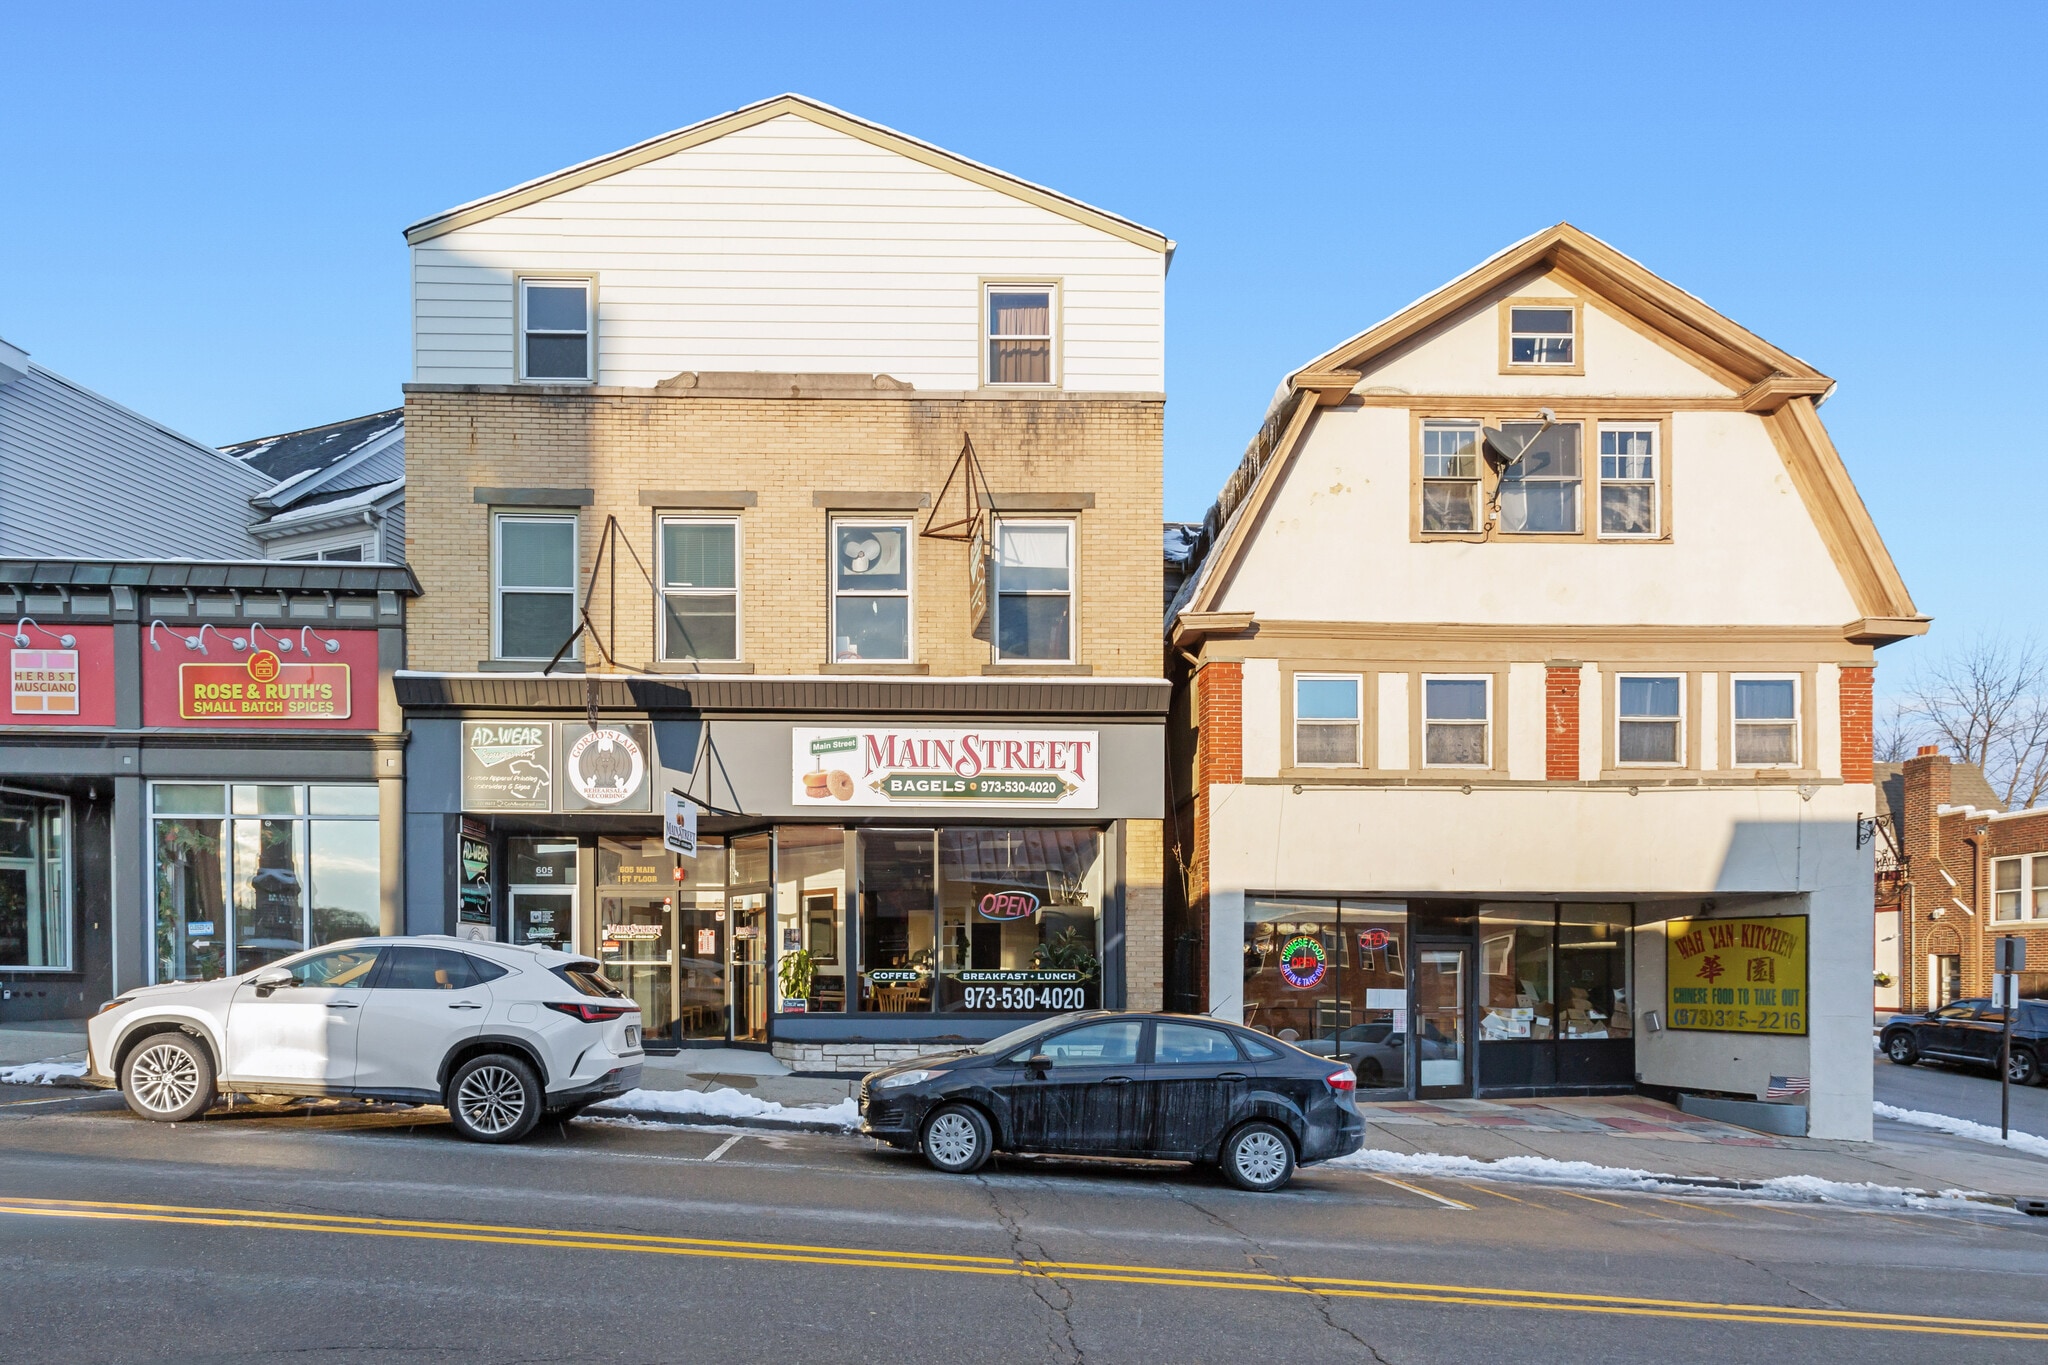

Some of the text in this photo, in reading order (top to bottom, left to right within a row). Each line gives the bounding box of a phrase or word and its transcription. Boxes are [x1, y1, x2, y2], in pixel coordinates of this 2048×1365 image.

[14, 671, 76, 682] HERBST
[14, 682, 77, 693] MUSCIANO
[193, 682, 333, 700] ROSE & RUTH'S
[193, 701, 334, 714] SMALL BATCH SPICES
[471, 726, 543, 746] AD-WEAR
[572, 730, 638, 759] GORZO'S LAIR
[812, 738, 856, 751] Main Street
[890, 779, 1057, 794] BAGELS 973-530-4020
[463, 840, 489, 862] AD-WEAR
[536, 866, 553, 874] 605
[619, 866, 656, 874] 605 MAIN
[618, 875, 658, 883] 1ST FLOOR
[980, 893, 1034, 918] OPEN
[1360, 932, 1389, 946] OPEN
[1674, 924, 1798, 960] WAH YAN KITCHEN
[1281, 937, 1325, 962] CHINESE FOOD
[1291, 956, 1317, 968] OPEN
[872, 972, 917, 980] COFFEE
[962, 972, 1077, 980] BREAKFAST LUNCH
[1281, 963, 1290, 975] EAT
[1289, 973, 1297, 983] IN
[1302, 974, 1319, 987] TAKE
[1315, 963, 1325, 979] OUT
[964, 986, 1085, 1010] 973-530-4020
[1673, 987, 1800, 1006] CHINESE FOOD TO TAKE OUT
